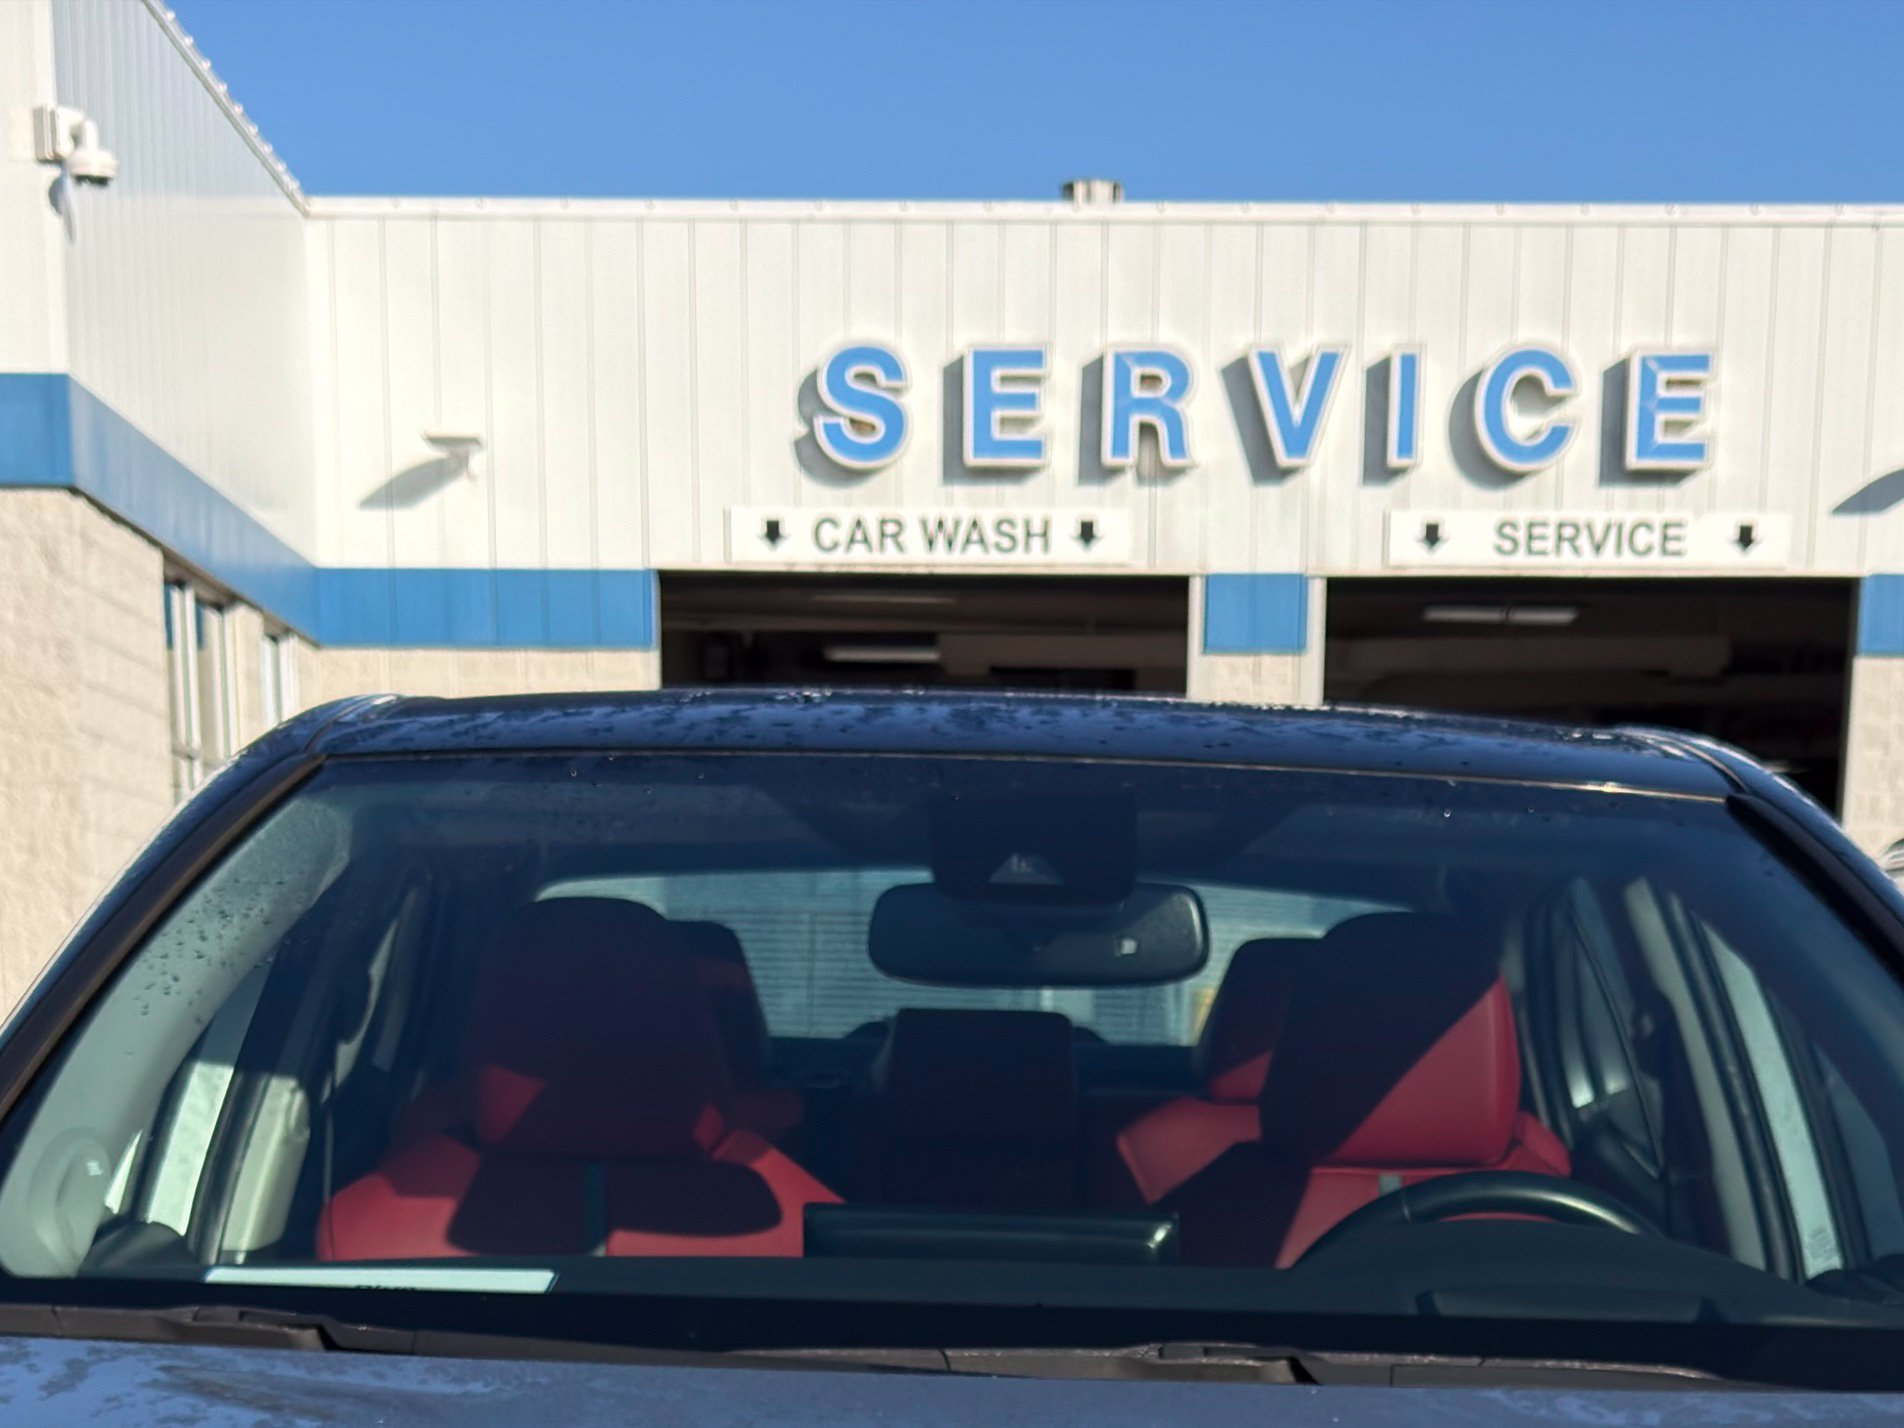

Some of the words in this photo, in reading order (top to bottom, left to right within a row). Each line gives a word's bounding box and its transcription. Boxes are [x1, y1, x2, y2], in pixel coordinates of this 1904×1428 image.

[810, 342, 1720, 472] SERVICE
[812, 517, 907, 554] CAR
[920, 517, 1052, 554] WASH
[1494, 519, 1688, 558] SERVICE
